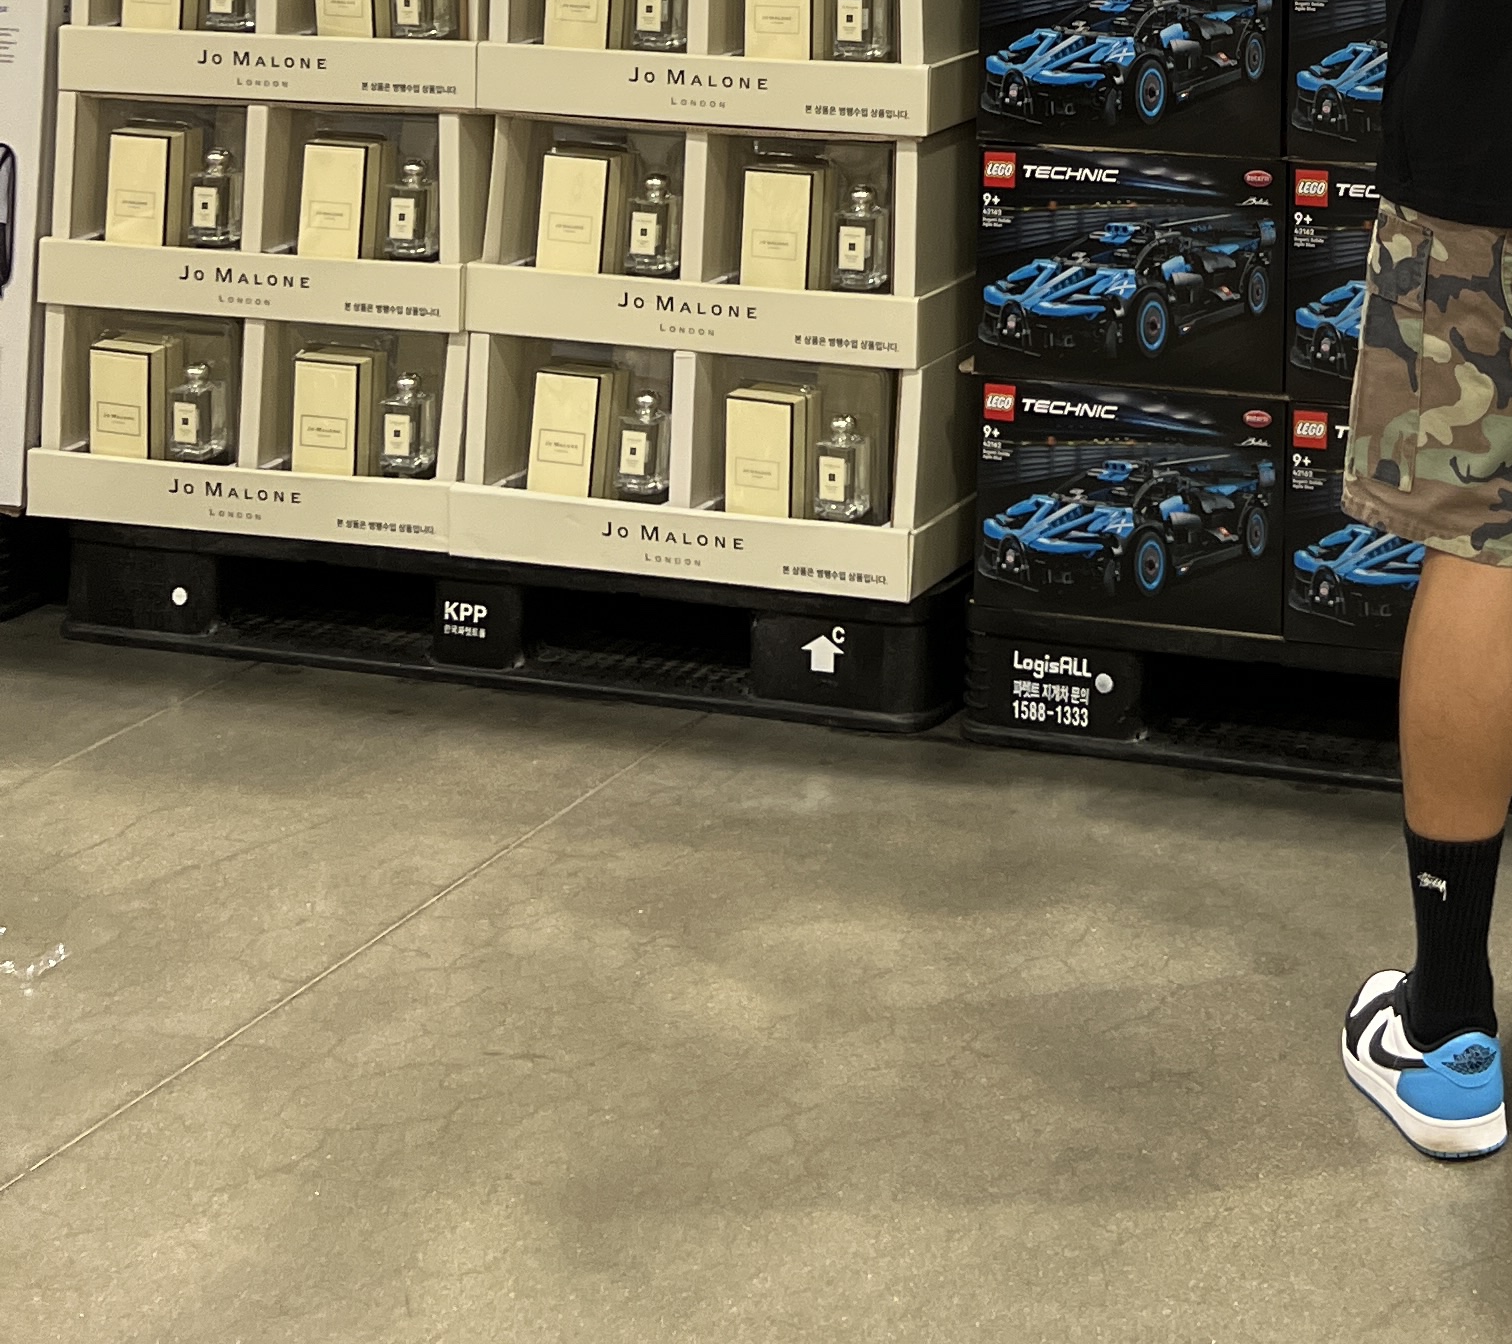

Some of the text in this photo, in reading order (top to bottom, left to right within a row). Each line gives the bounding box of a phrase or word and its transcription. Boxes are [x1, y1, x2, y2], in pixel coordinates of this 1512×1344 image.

[601, 522, 745, 550] Jo Malone
[444, 601, 487, 623] KPP
[832, 627, 845, 644] C
[1013, 650, 1092, 678] LogisALL
[1071, 687, 1089, 705] 문의
[1013, 700, 1088, 727] 1588-1333
